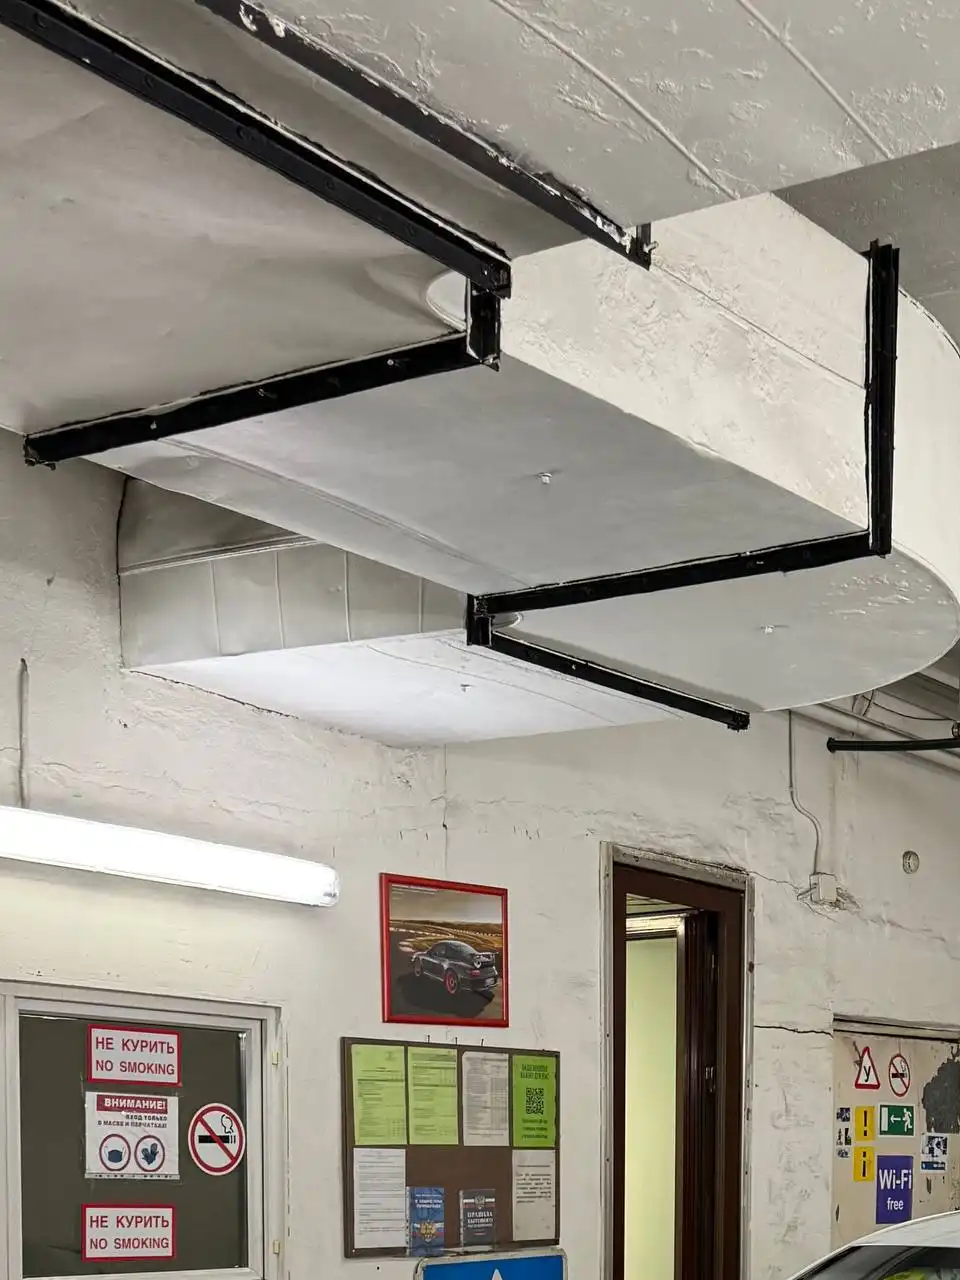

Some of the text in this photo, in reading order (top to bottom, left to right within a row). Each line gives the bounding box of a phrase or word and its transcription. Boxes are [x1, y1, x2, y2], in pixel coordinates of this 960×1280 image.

[95, 1036, 175, 1055] НЕ КУРИТЬ
[95, 1060, 175, 1075] NO SMOKING
[104, 1097, 166, 1110] ВНИМАНИЕ!
[879, 1169, 912, 1190] Wi-Fi
[886, 1197, 904, 1211] free
[89, 1215, 170, 1228] НЕ КУРИТЬ
[89, 1237, 170, 1249] NO SMOKING
